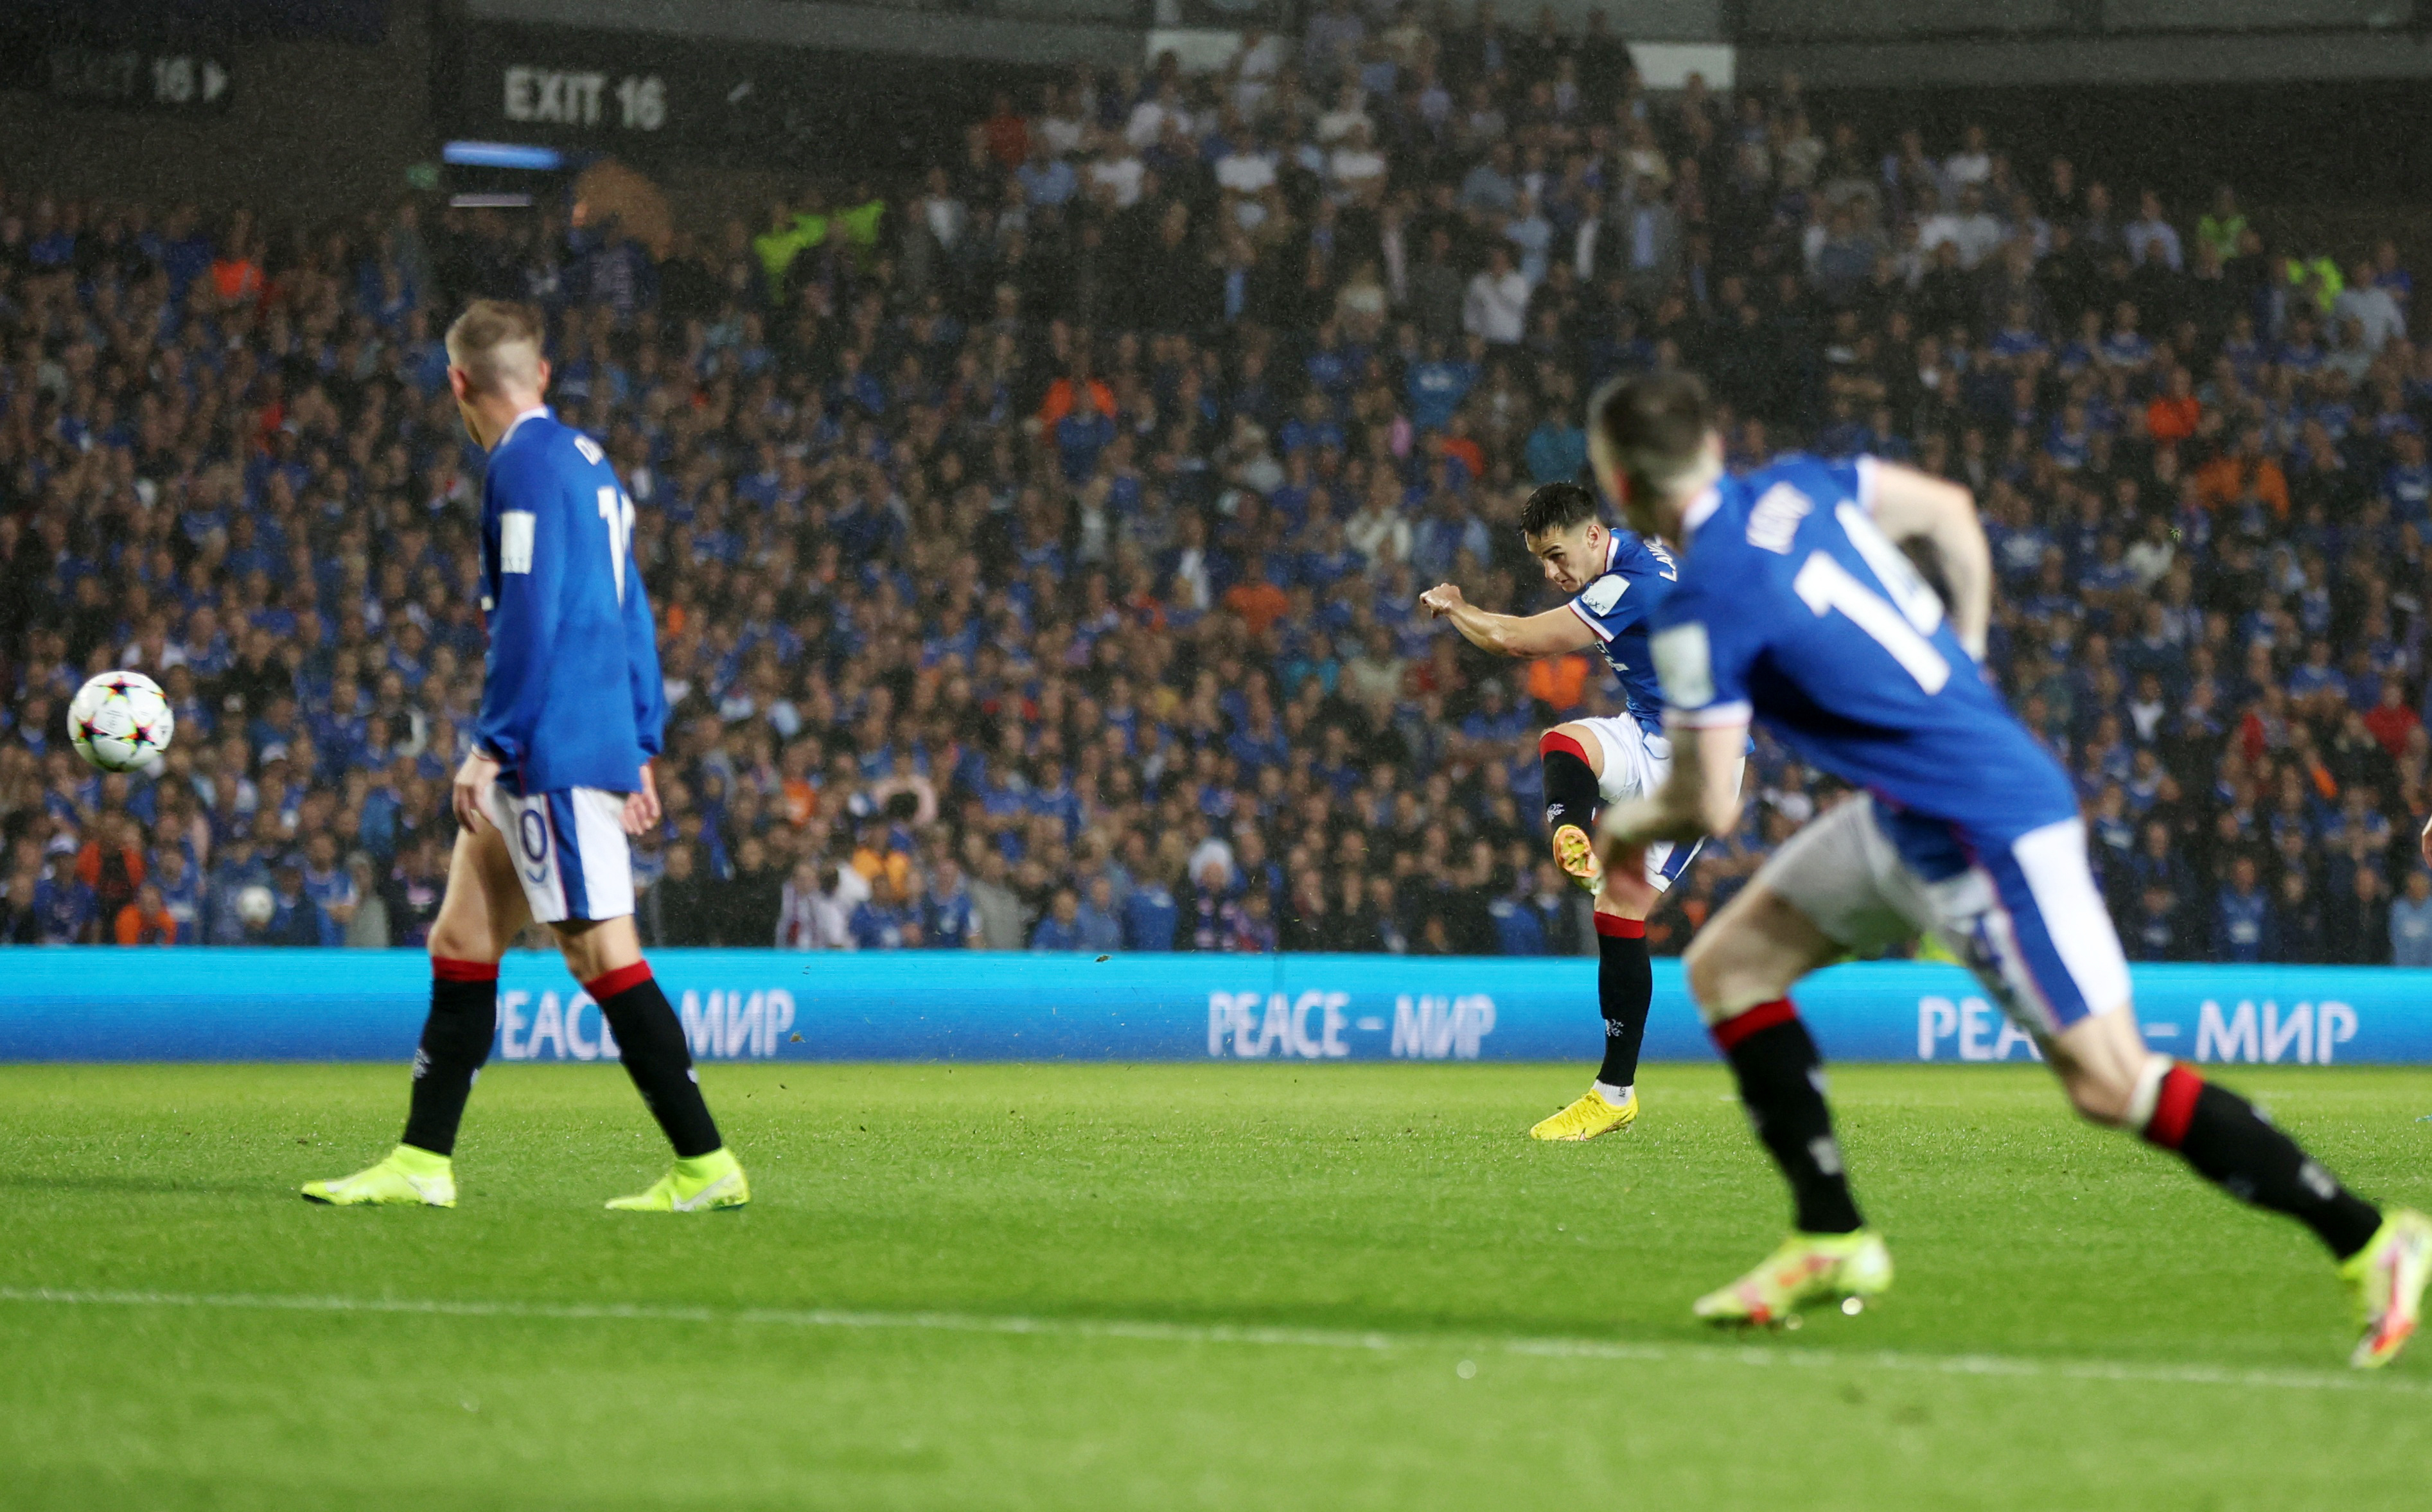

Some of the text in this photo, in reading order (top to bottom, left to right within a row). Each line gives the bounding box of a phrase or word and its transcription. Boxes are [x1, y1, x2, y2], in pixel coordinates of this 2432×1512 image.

[504, 65, 667, 131] EXIT 16
[496, 990, 622, 1060] EAC
[1208, 989, 1350, 1059] PEACE
[1916, 996, 2041, 1062] PEA
